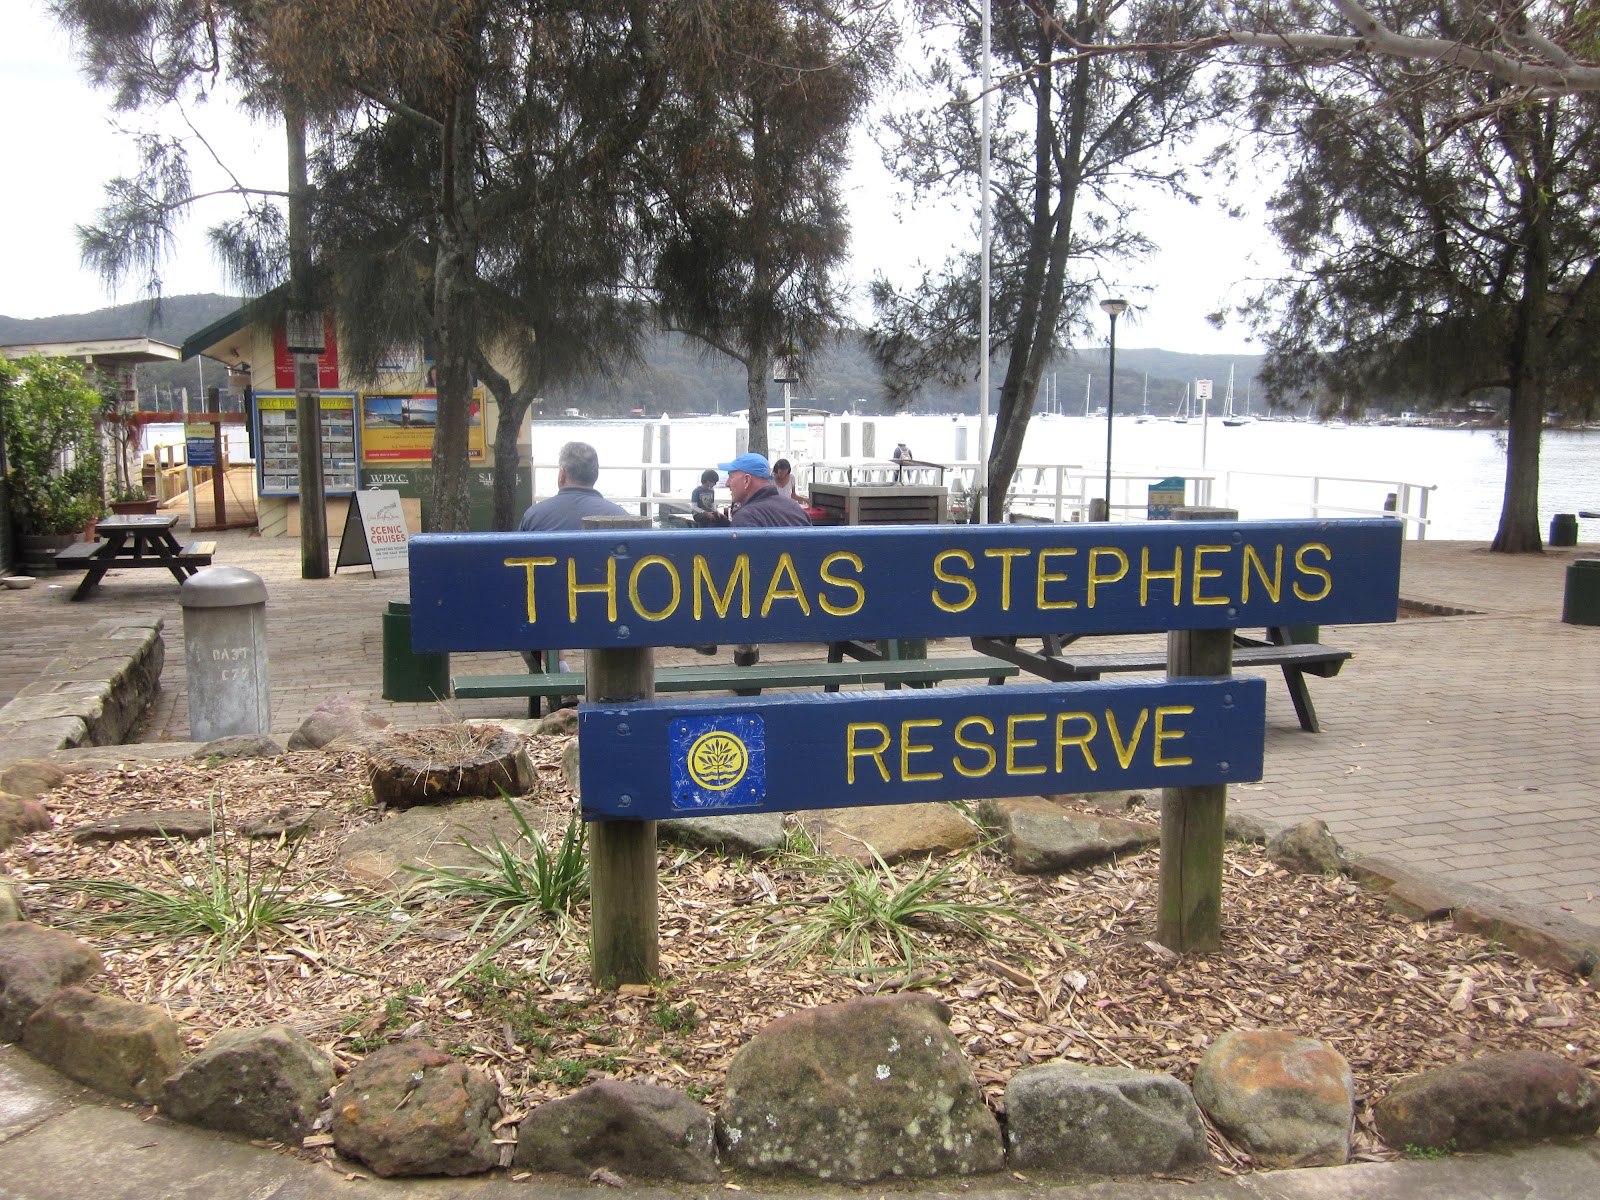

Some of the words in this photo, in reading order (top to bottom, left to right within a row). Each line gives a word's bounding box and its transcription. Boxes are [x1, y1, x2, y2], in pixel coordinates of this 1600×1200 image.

[370, 473, 409, 482] W.P.Y.C.
[370, 525, 402, 535] SCENIC
[370, 534, 406, 544] CRUISES
[503, 550, 866, 624] THOMAS
[931, 542, 1333, 613] STEPHENS
[847, 704, 1195, 785] RESERVE
